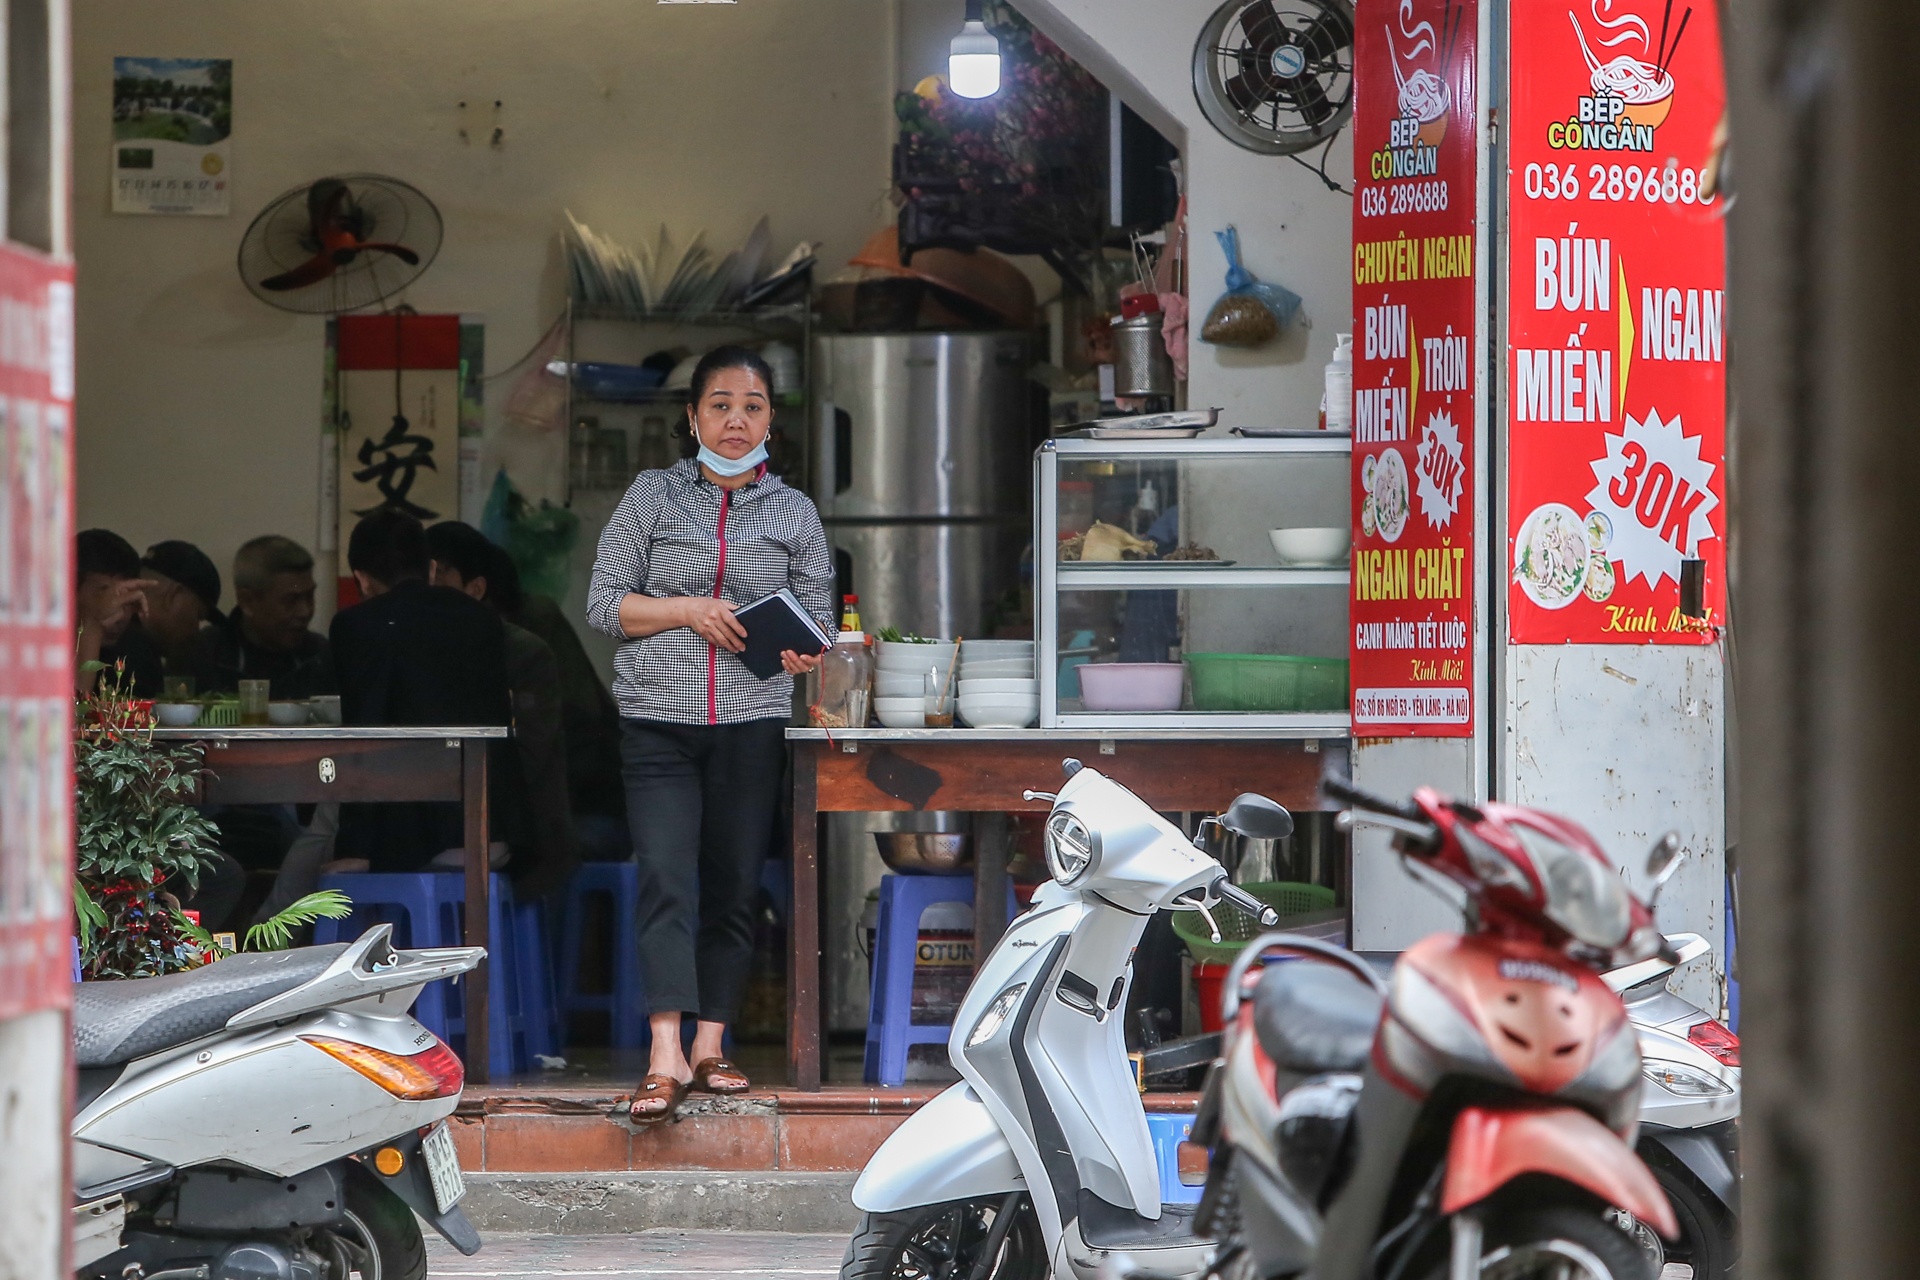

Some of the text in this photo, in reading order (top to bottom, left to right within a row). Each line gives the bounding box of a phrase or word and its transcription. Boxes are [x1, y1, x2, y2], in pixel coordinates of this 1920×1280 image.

[1391, 106, 1418, 147] BẾP
[1578, 87, 1625, 123] BẾP
[1548, 117, 1654, 151] CÔNGÂN
[1371, 139, 1437, 179] CÔNGÂN
[1362, 180, 1448, 217] 036 2896888
[1524, 162, 1580, 200] 036
[1356, 230, 1471, 285] CHUYÊN NGAN
[1535, 221, 1610, 312] BÚN
[1365, 293, 1407, 360] BÚN
[1642, 287, 1722, 362] NGAN
[1423, 324, 1467, 404] TRỘN
[1516, 322, 1611, 422] MIẾN
[1356, 367, 1406, 443] MIẾN
[1423, 430, 1459, 508] 30K
[1608, 440, 1707, 556] 30K
[1356, 536, 1465, 611] NGAN CHẶT
[1356, 612, 1466, 655] CANH MĂNG TIẾT LUỘC
[1601, 604, 1658, 633] Kính
[1409, 659, 1437, 681] Kính
[1399, 699, 1407, 716] 53
[1446, 694, 1455, 716] HÀ
[1456, 694, 1468, 721] NỘI
[918, 944, 974, 961] OTUN
